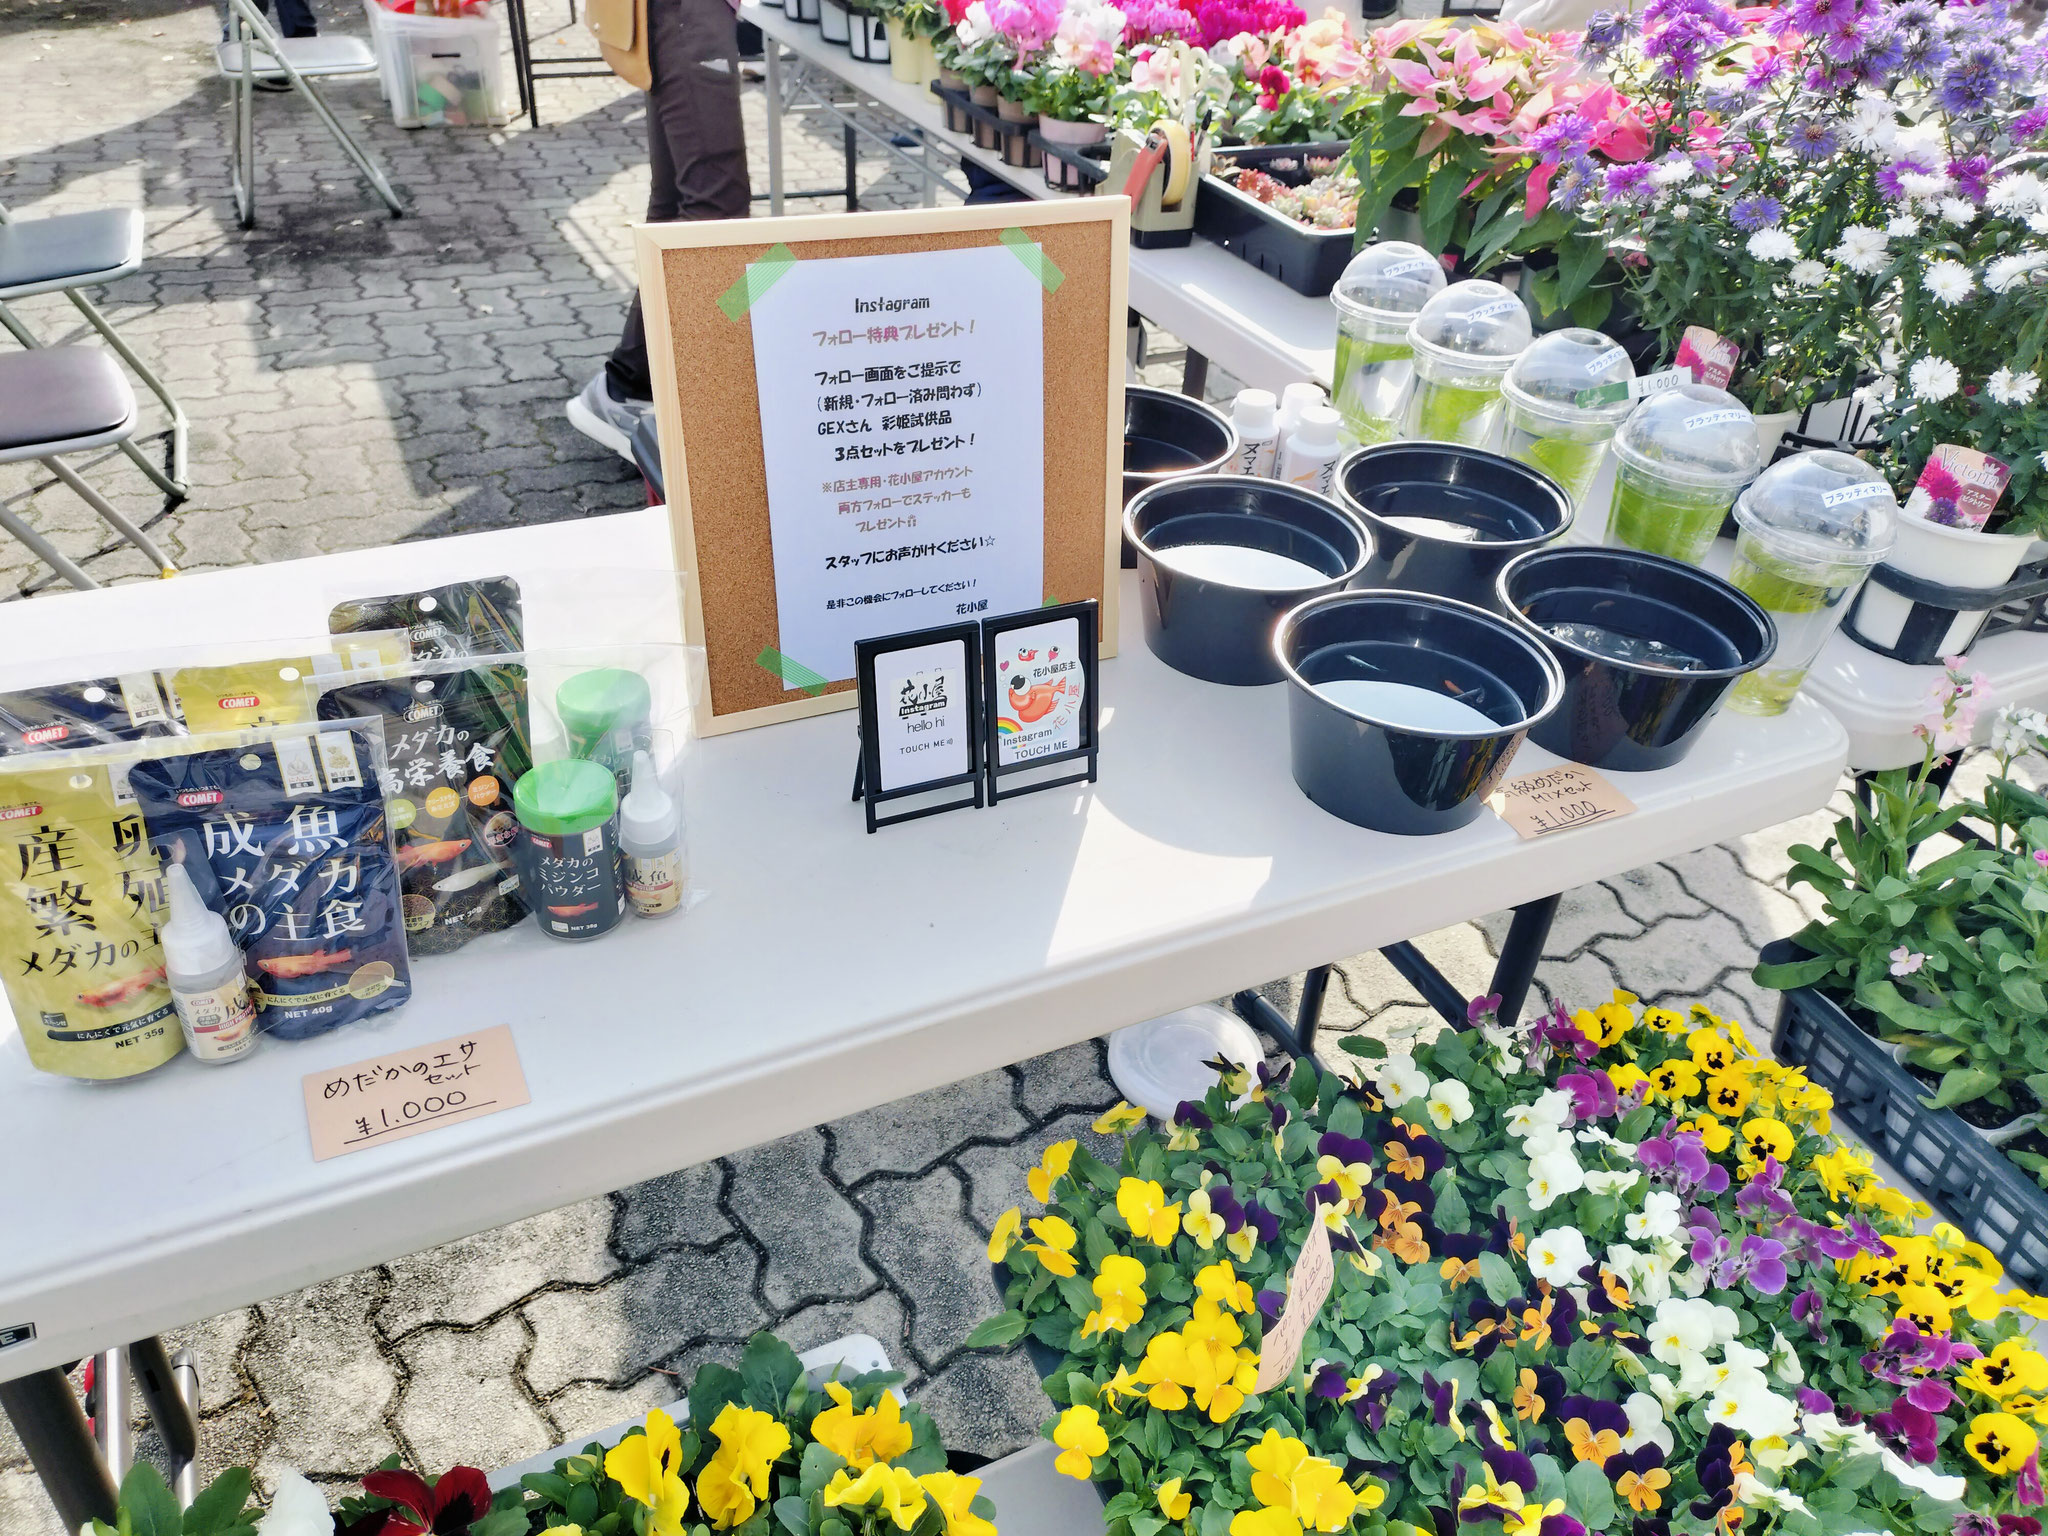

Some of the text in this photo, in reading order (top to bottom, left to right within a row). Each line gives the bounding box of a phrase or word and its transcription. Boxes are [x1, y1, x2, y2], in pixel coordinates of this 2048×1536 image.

[855, 296, 930, 313] Instagram
[812, 319, 976, 347] フォロー特典プレゼント！
[814, 360, 962, 385] フォロー画面をご提示で
[817, 410, 952, 436] GEXさん 彩姫試供品
[1241, 443, 1260, 475] ヌマエ
[1941, 447, 1999, 488] Victoria
[837, 488, 972, 515] 両方フォローでステッカーも
[1967, 489, 1992, 501] アスター
[855, 518, 906, 533] プレゼント
[956, 599, 989, 615] 花小屋
[414, 627, 443, 641] COMET
[1033, 660, 1077, 679] 花小屋店主
[900, 675, 947, 706] 花小屋
[222, 697, 255, 708] COMET
[900, 701, 946, 715] Instagram
[408, 705, 440, 720] COMET
[906, 715, 945, 735] hello hi
[28, 727, 64, 743] COMET
[390, 725, 470, 760] メダカの
[1003, 728, 1053, 747] Instagram
[900, 739, 946, 755] TOUCH ME
[1015, 740, 1068, 760] TOUCH ME
[379, 743, 496, 796] 高栄養食
[183, 792, 217, 805] COMET
[0, 807, 37, 820] COMET
[203, 805, 349, 860] 成魚
[541, 857, 594, 868] メダカの
[219, 860, 358, 897] メダカ
[539, 867, 599, 883] ミジンコ
[540, 883, 602, 897] パウダー
[229, 899, 366, 941] の主食
[445, 914, 465, 925] NET
[267, 987, 346, 1004] にんにくで元気に育てる
[284, 1005, 333, 1019] NET 40g
[77, 1007, 169, 1039] にんにくで元気に育てる
[115, 1027, 164, 1049] NET 35g
[324, 1041, 477, 1099] めだかのエサ
[425, 1064, 481, 1084] セット
